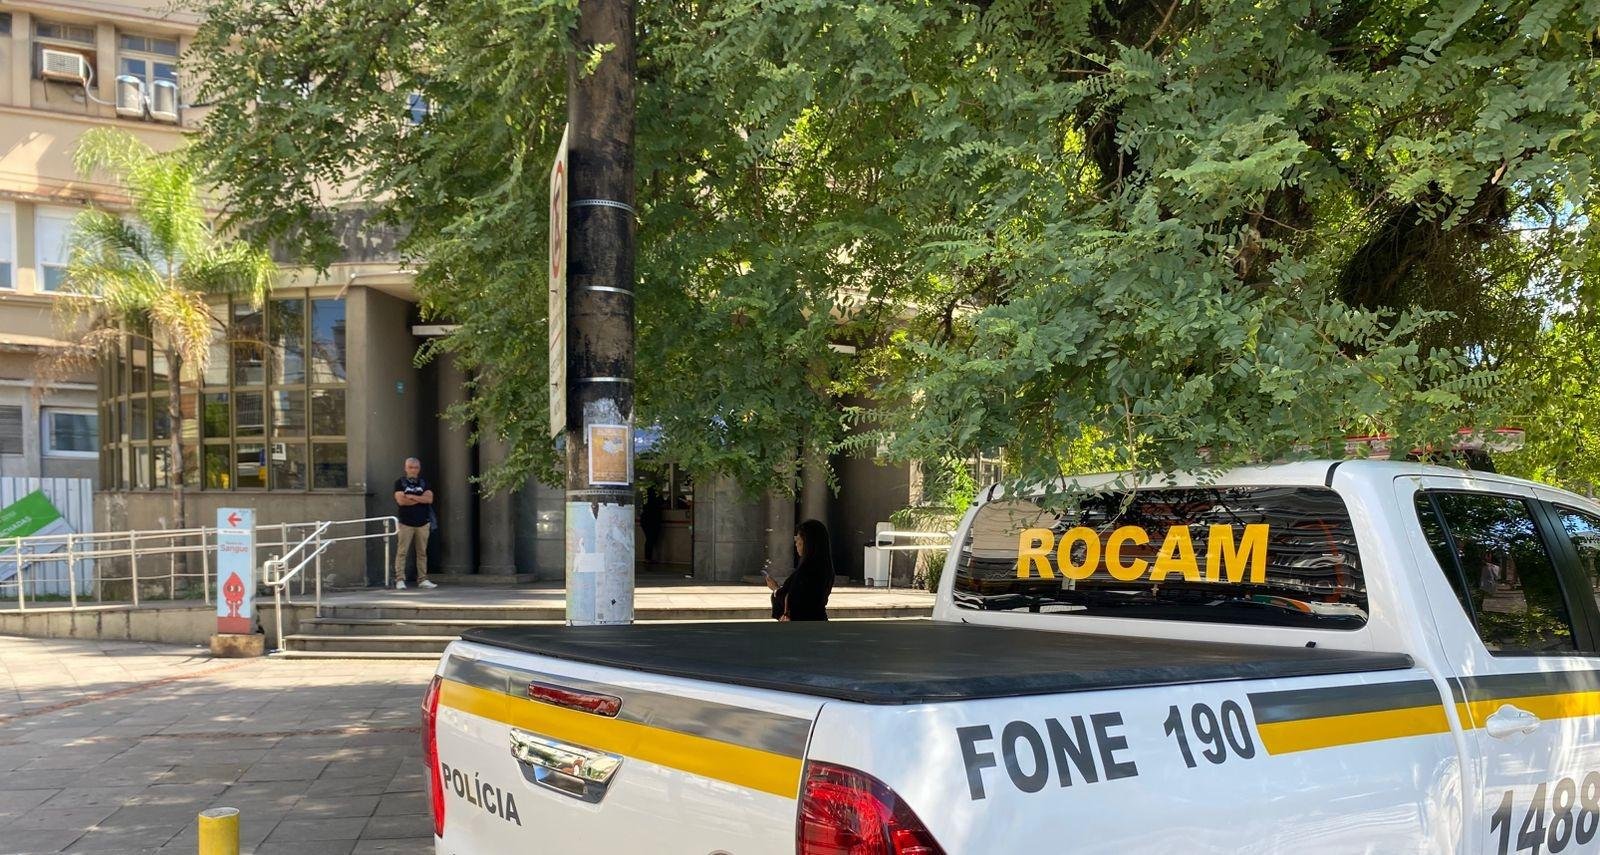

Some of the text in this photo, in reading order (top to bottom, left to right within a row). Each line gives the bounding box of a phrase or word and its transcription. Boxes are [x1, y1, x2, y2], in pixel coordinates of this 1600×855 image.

[220, 544, 249, 554] Sangue
[1017, 523, 1269, 584] ROCAM
[956, 699, 1256, 801] FONE 190
[442, 762, 522, 827] POLÍCIA
[1490, 771, 1600, 855] 1488
